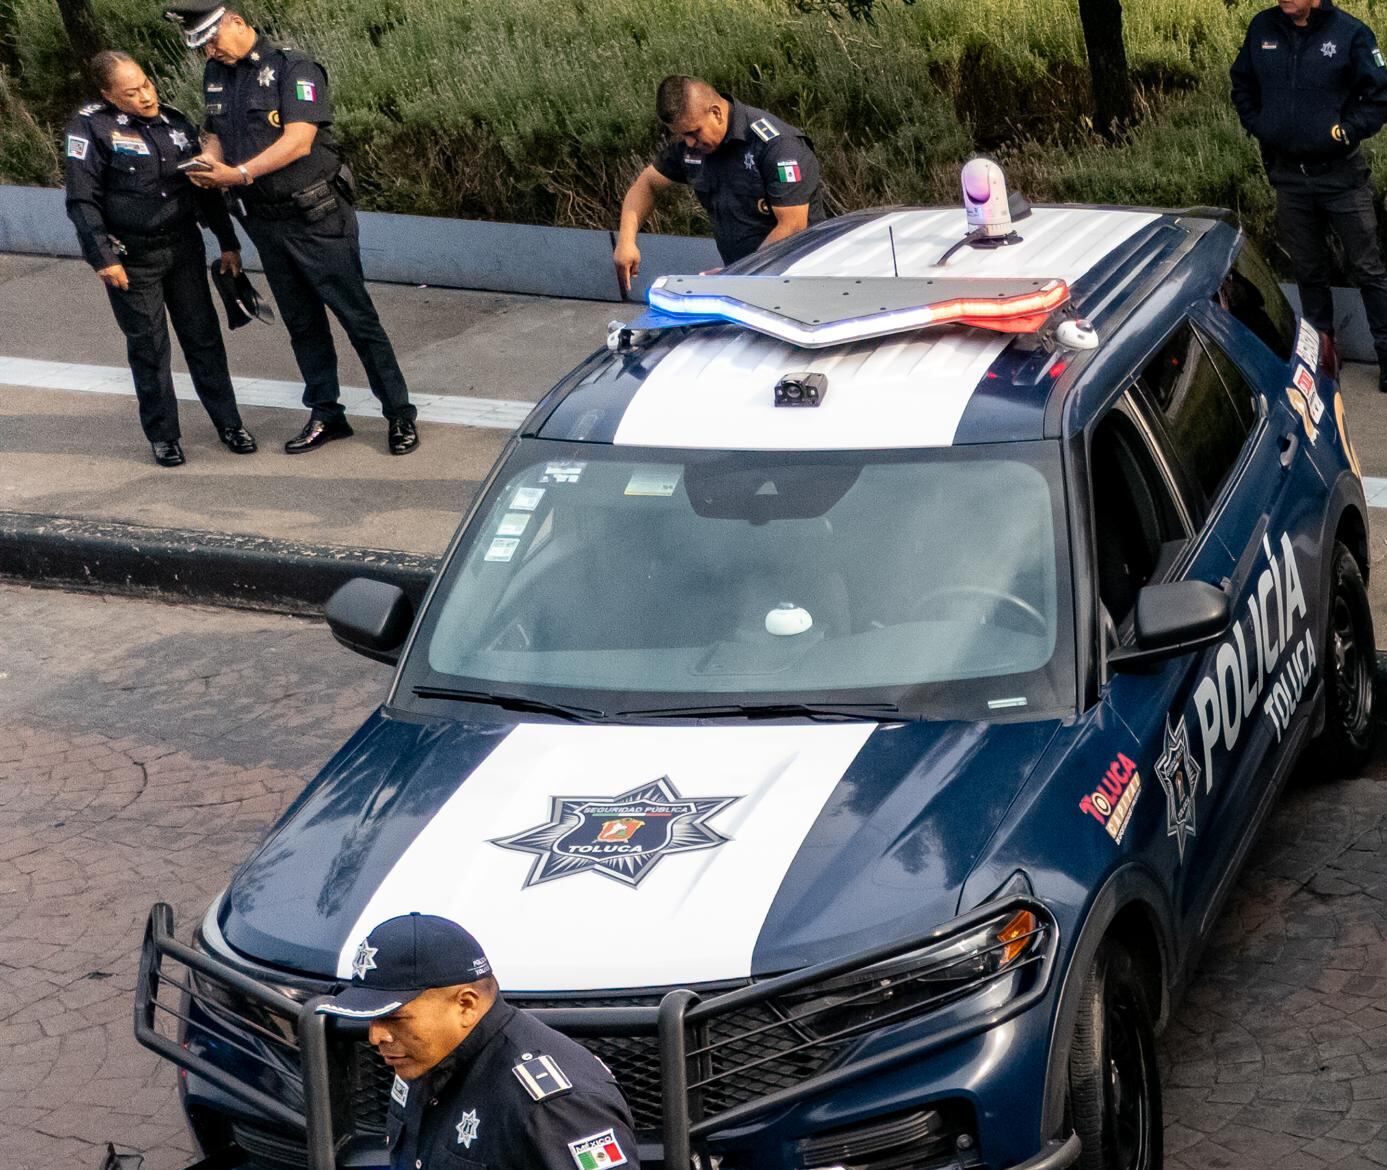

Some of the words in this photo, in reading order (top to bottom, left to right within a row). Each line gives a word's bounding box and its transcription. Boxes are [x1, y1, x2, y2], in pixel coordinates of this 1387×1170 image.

[1194, 531, 1307, 795] POLICÍA
[1263, 627, 1317, 743] TOLUCA
[584, 806, 643, 814] SEGURIDAD
[644, 805, 688, 814] PÚBLICA
[1079, 752, 1137, 825] TOLUCA
[568, 844, 643, 853] TOLUCA
